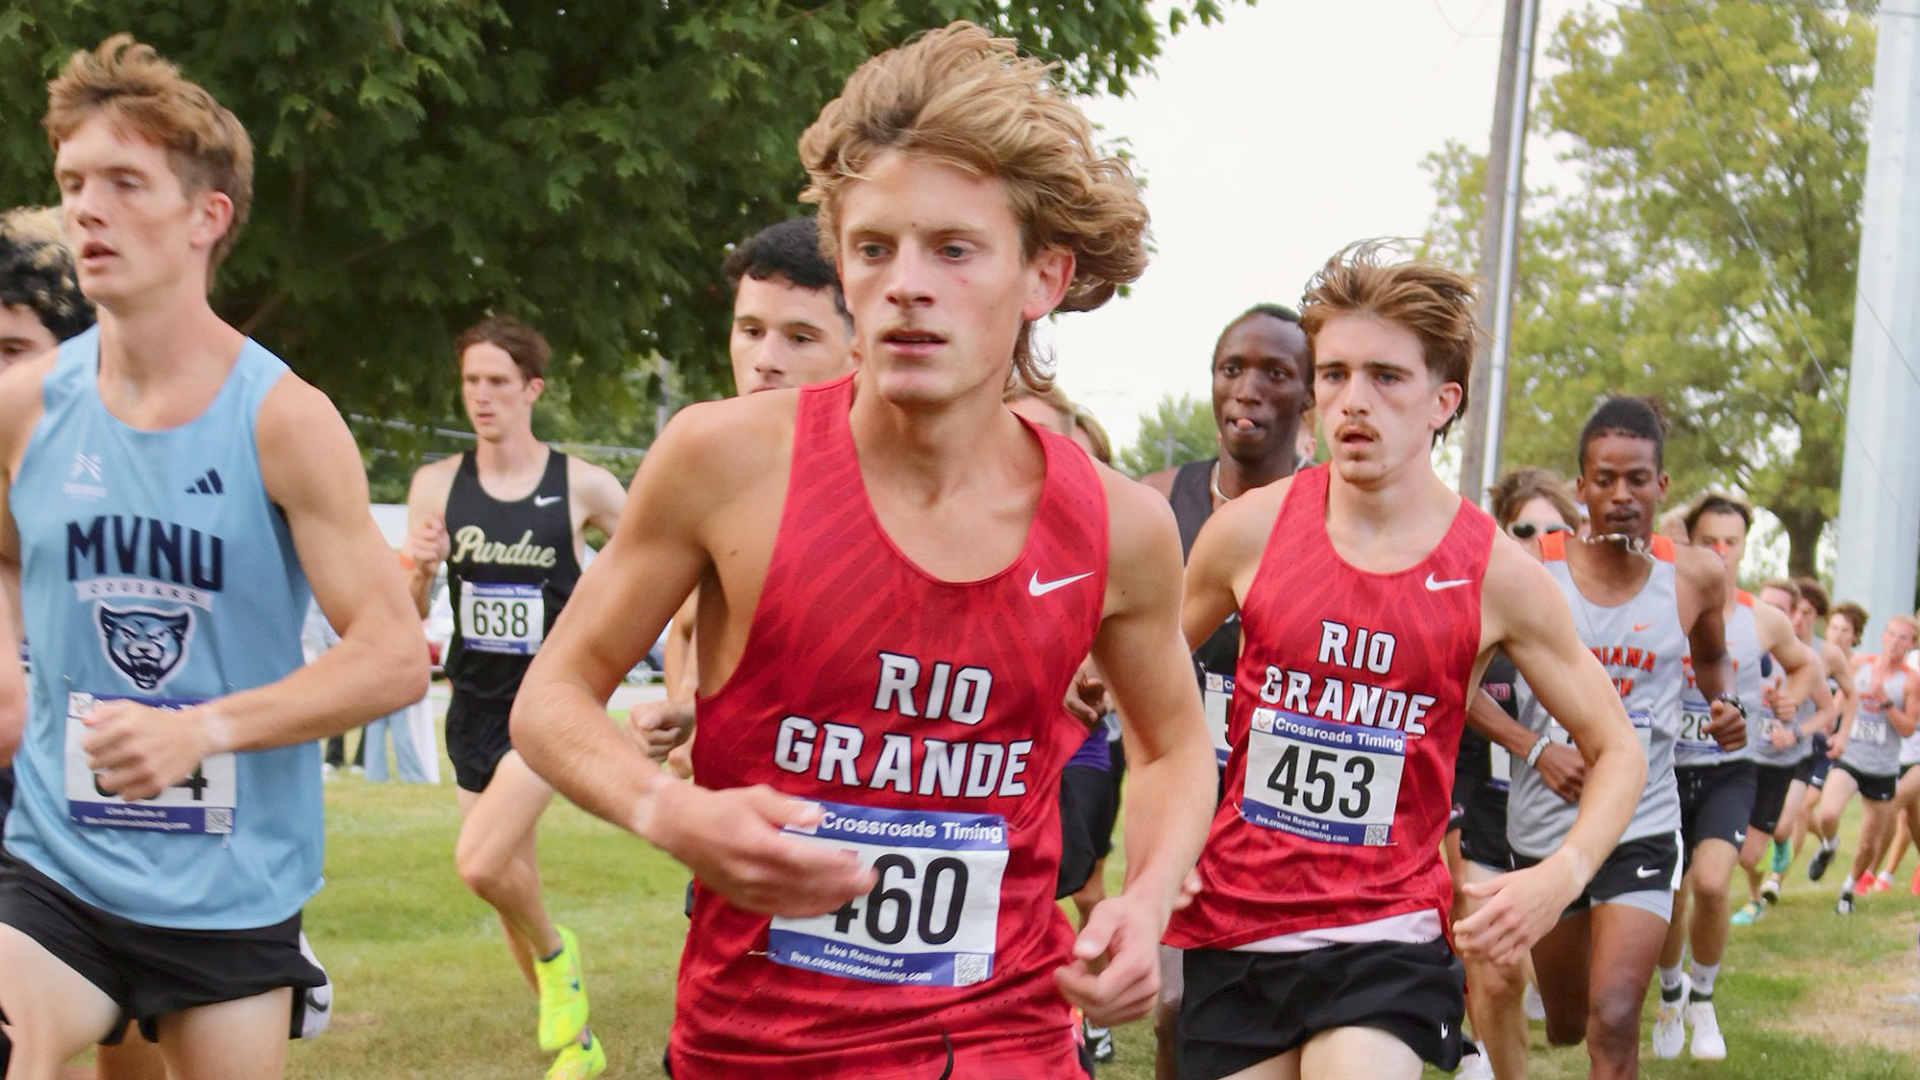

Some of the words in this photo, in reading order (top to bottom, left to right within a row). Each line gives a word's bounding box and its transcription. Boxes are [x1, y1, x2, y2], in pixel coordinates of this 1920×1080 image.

[66, 514, 223, 592] MVNU
[453, 525, 556, 568] Purdue
[472, 600, 529, 638] 638
[1317, 619, 1397, 675] RIO
[873, 651, 993, 726] RIO
[1259, 664, 1437, 735] GRANDE
[772, 714, 1035, 799] GRANDE
[1274, 716, 1353, 744] Crossroads
[1356, 732, 1404, 752] Timing
[1266, 744, 1376, 819] 453
[820, 811, 937, 839] Crossroads
[941, 821, 1003, 845] Timing
[1277, 811, 1291, 821] Live
[1292, 815, 1319, 828] Results
[1321, 823, 1330, 831] at
[823, 943, 847, 955] Live
[849, 948, 889, 966] Results
[891, 957, 905, 968] at
